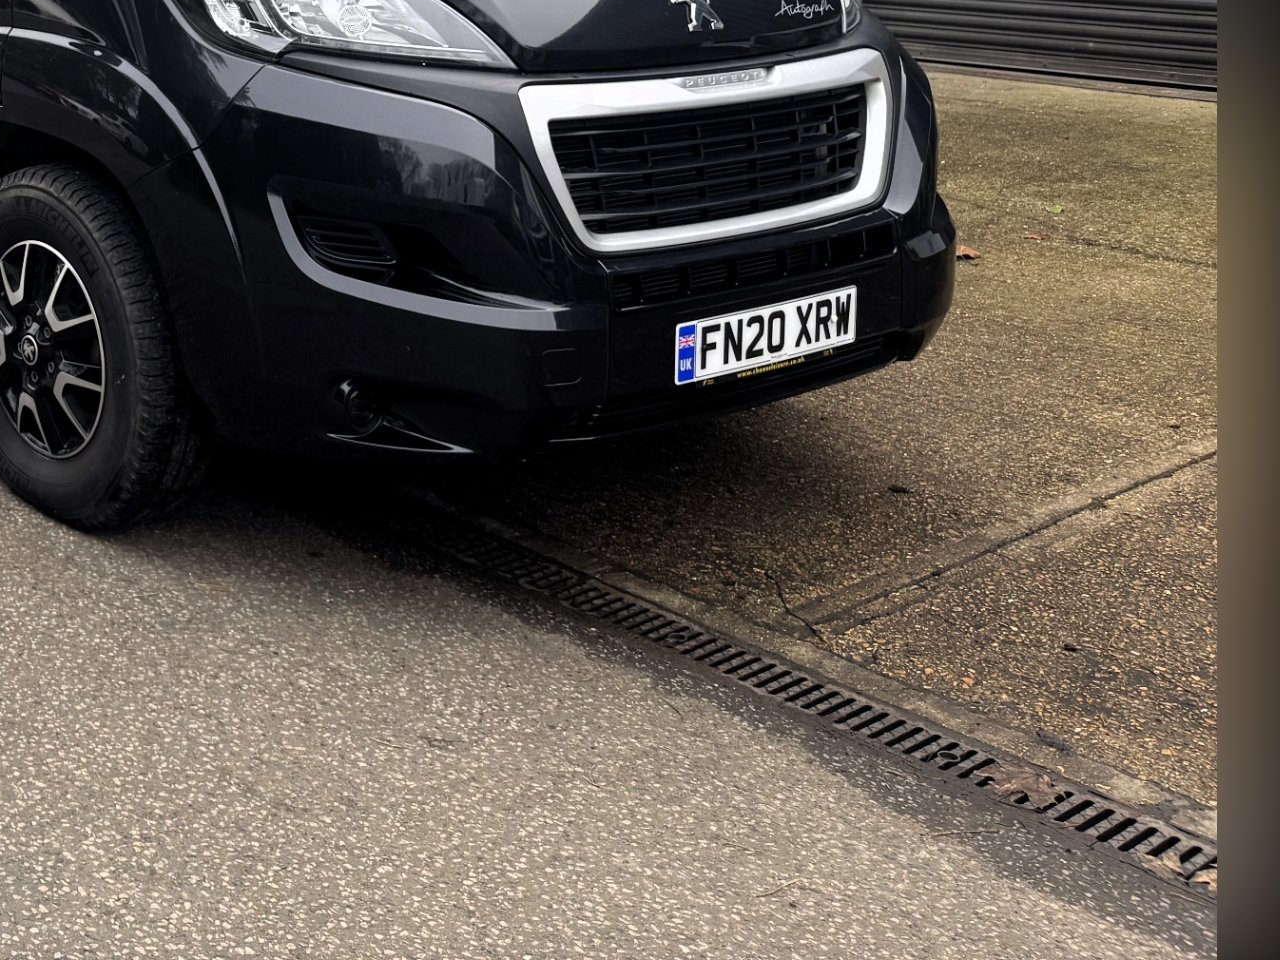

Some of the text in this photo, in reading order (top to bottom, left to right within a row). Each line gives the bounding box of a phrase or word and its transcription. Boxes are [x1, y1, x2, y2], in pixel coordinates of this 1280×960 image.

[685, 71, 760, 88] PEUGEOT
[700, 293, 852, 370] FN20 XRW
[680, 356, 692, 371] UK
